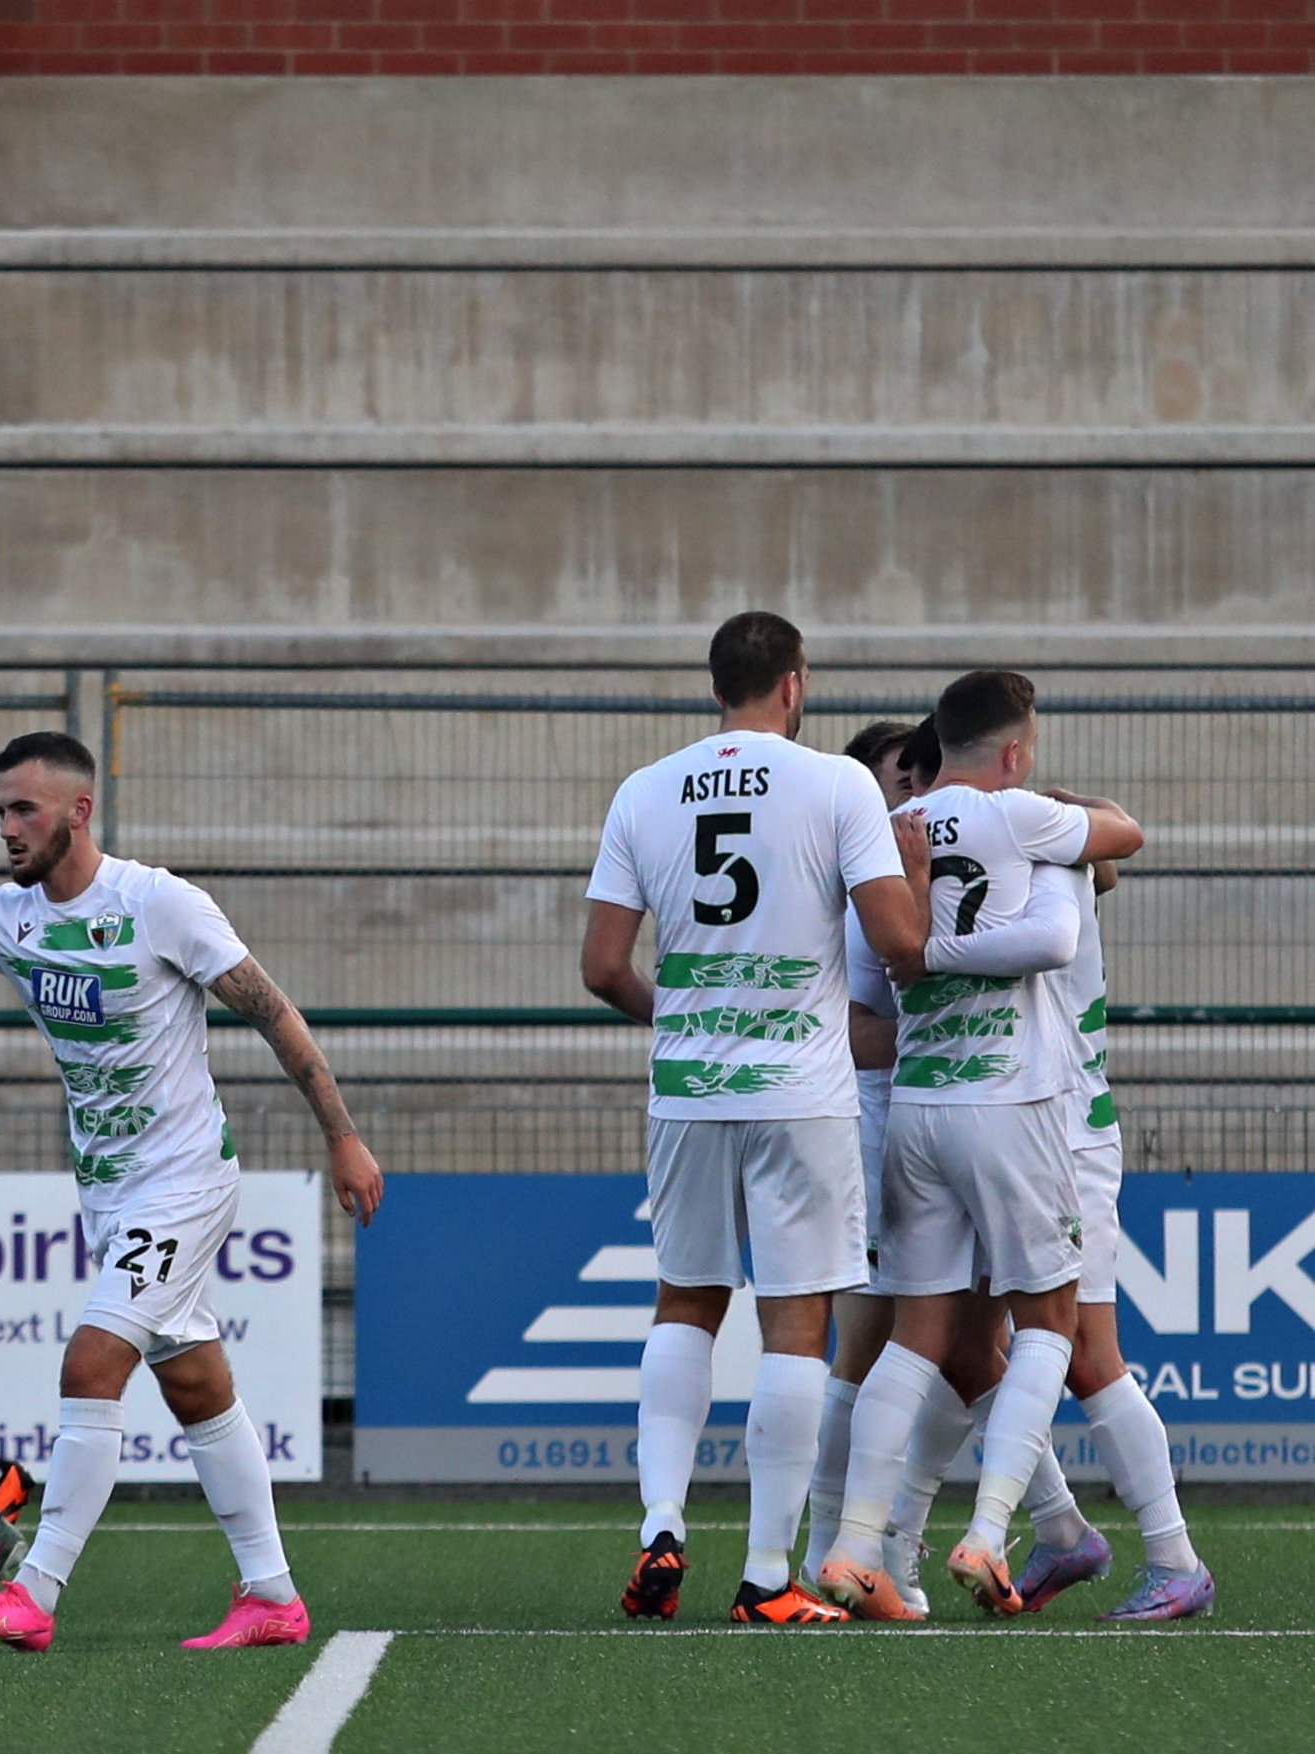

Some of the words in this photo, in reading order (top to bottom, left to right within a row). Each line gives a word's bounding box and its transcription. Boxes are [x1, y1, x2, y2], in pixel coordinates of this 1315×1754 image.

[680, 766, 770, 804] ASTLES
[692, 811, 760, 926] 5
[39, 972, 94, 1010] RUK
[40, 1003, 97, 1024] GROUP.COM
[115, 1228, 179, 1284] 21
[1233, 1362, 1315, 1400] SU
[498, 1439, 613, 1468] 01691
